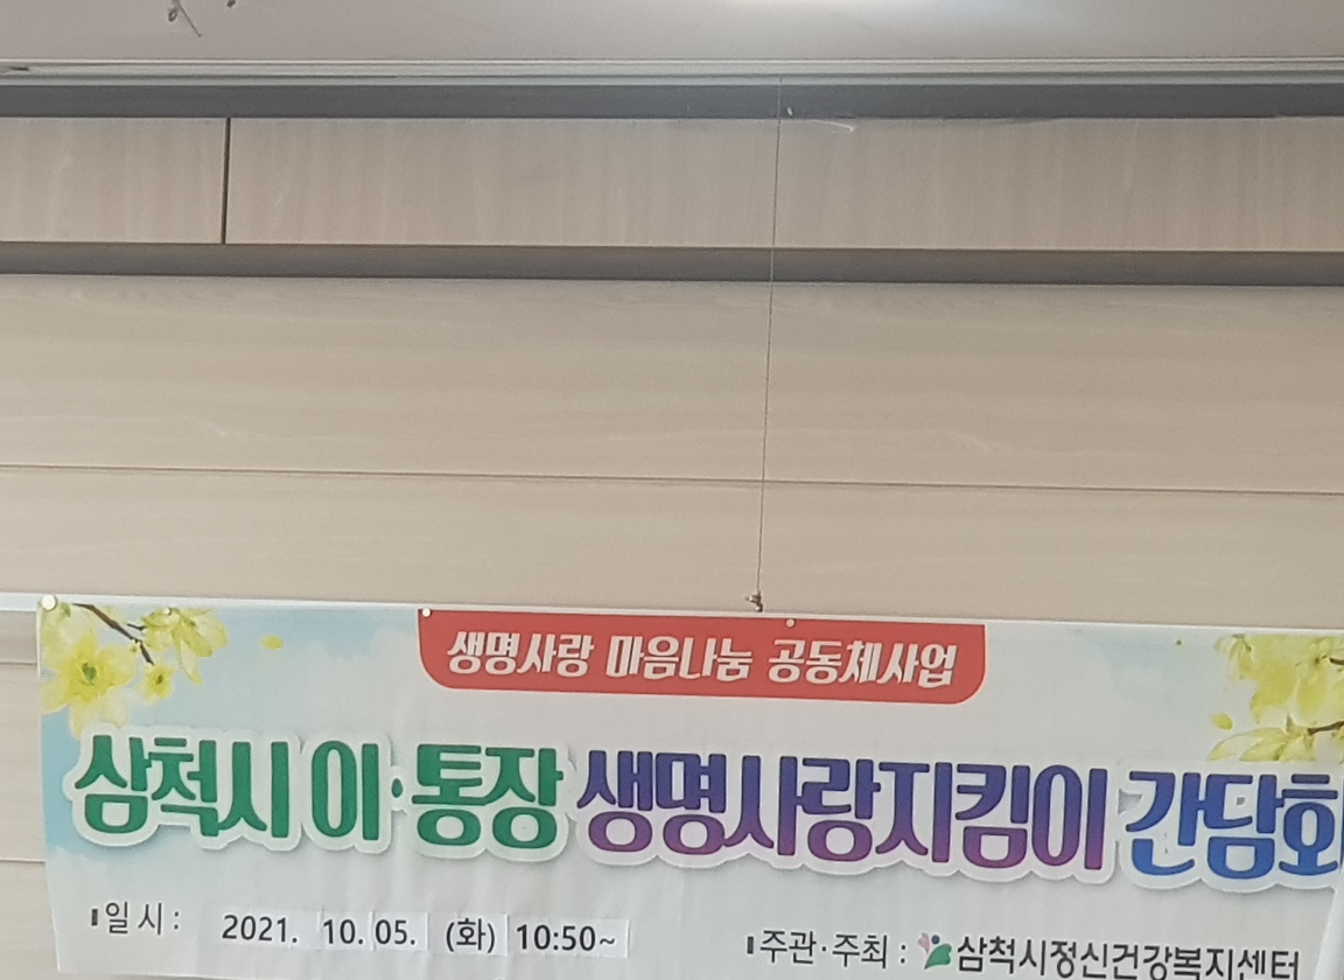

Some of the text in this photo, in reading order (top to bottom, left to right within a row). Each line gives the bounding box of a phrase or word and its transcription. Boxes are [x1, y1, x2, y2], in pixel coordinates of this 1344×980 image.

[447, 631, 957, 688] 생명사랑 마음나눔 공동체사업
[74, 735, 290, 838] 삼척시
[576, 750, 1108, 870] 생명사랑지킴이
[222, 914, 298, 943] 2021.
[323, 918, 364, 945] 10.
[375, 919, 416, 946] 05.
[446, 917, 495, 953] (화)
[516, 924, 616, 951] 10:50~
